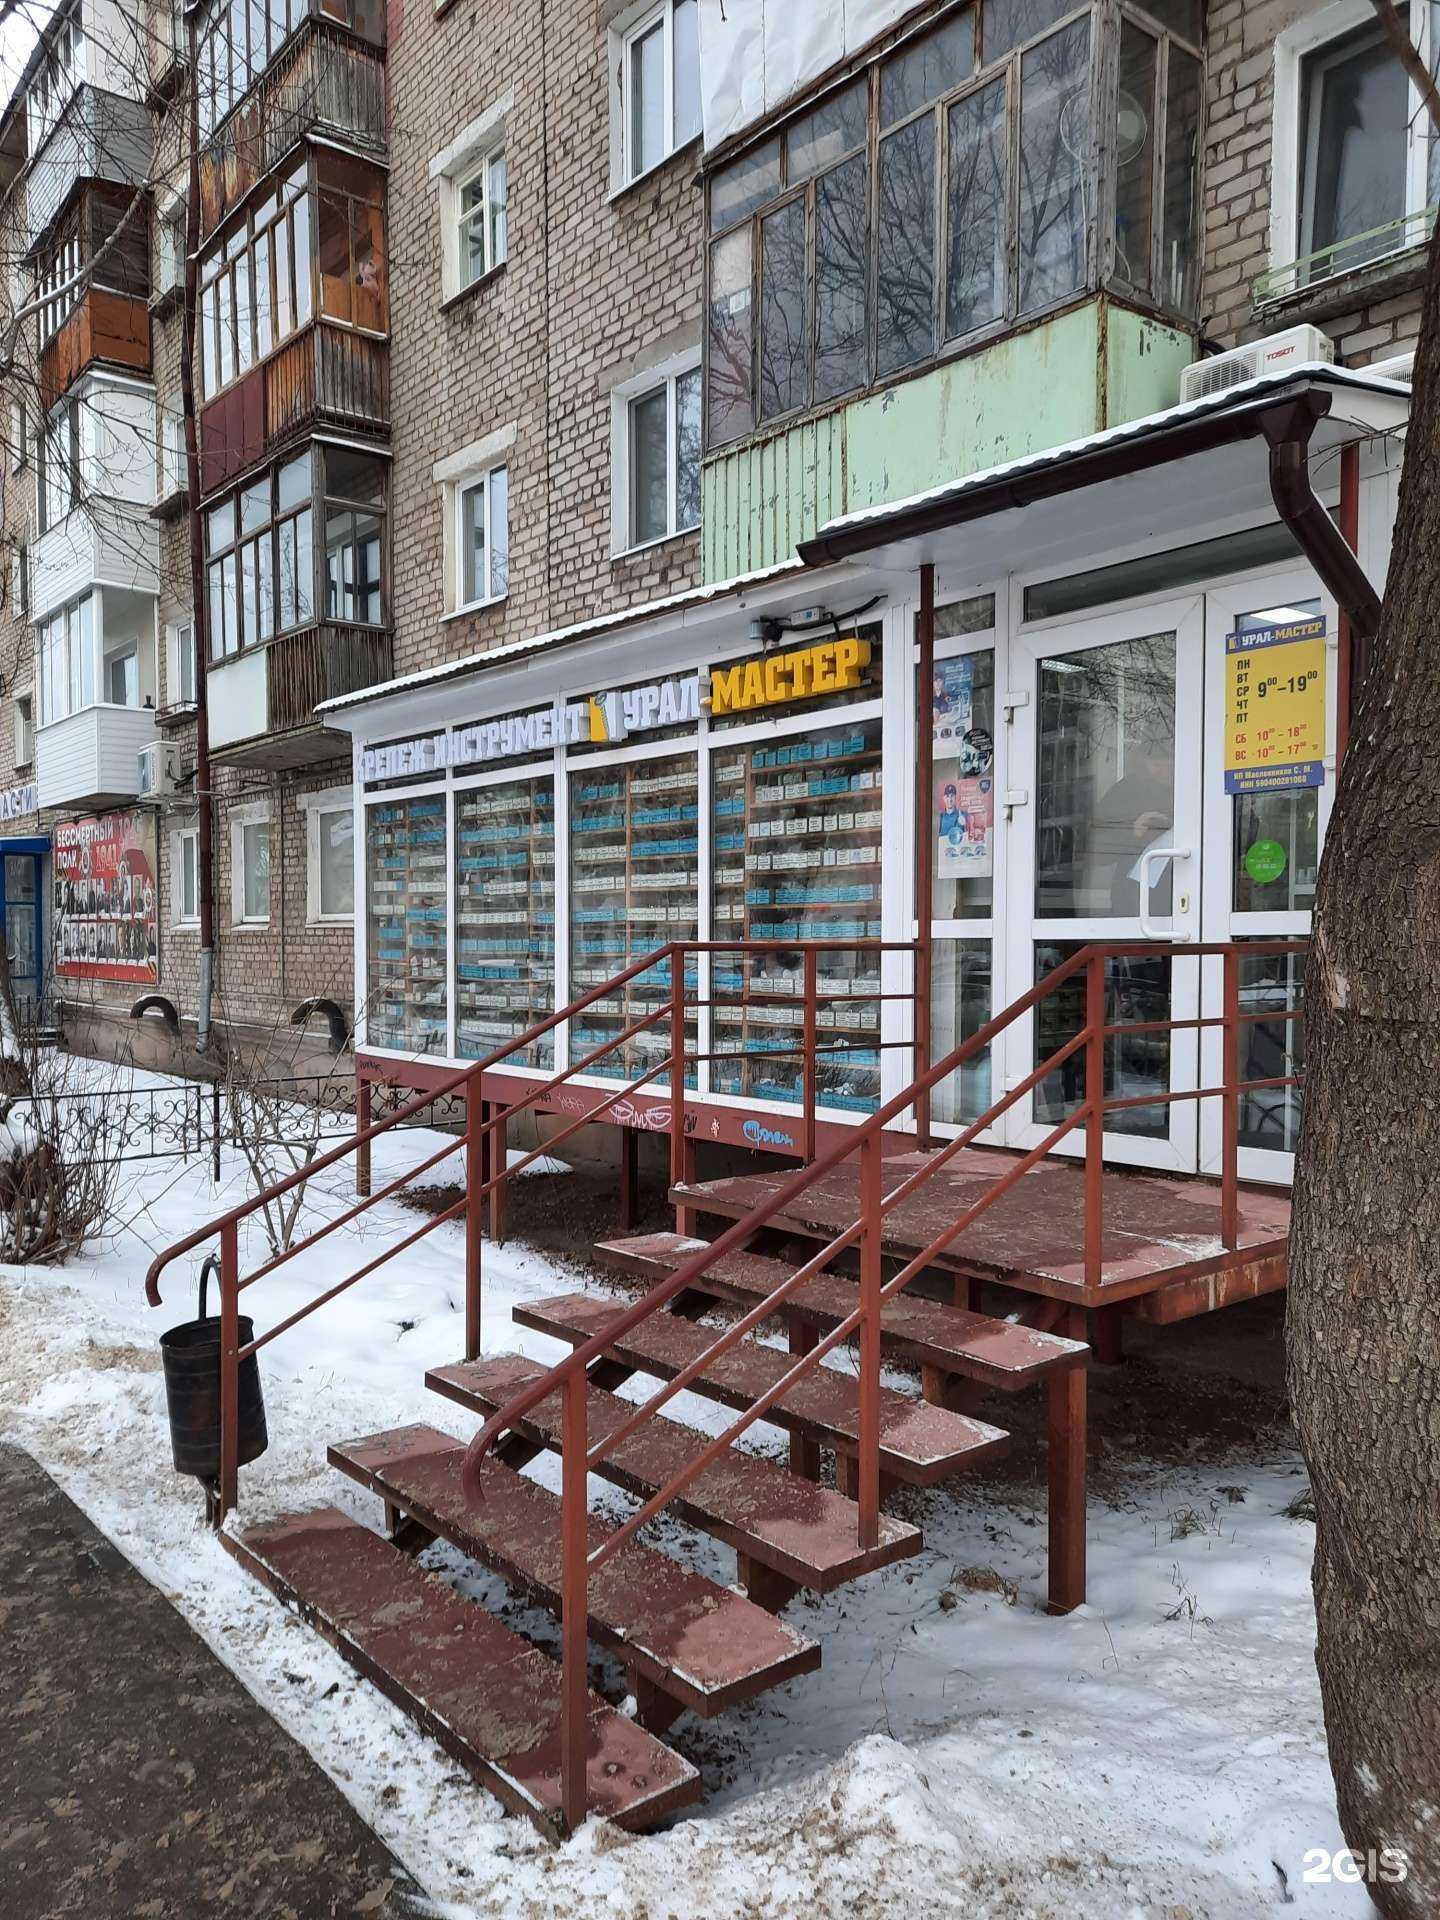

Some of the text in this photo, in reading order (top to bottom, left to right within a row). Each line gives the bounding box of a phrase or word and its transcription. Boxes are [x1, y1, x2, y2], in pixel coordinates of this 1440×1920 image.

[1266, 345, 1296, 361] TOSOT
[1242, 622, 1322, 646] УРАЛ-МАСТЕР
[1237, 659, 1250, 670] ПН
[1237, 673, 1249, 684] ВТ
[1236, 686, 1250, 697] СР
[1236, 699, 1249, 710] ЧТ
[1236, 713, 1249, 723] ПТ
[433, 703, 588, 769] ИНСТРУМЕНТ
[1235, 733, 1247, 744] СБ
[1235, 750, 1247, 760] ВС
[57, 816, 113, 848] БЕССМЕРТНЫЙ
[57, 850, 77, 869] ПОЛК
